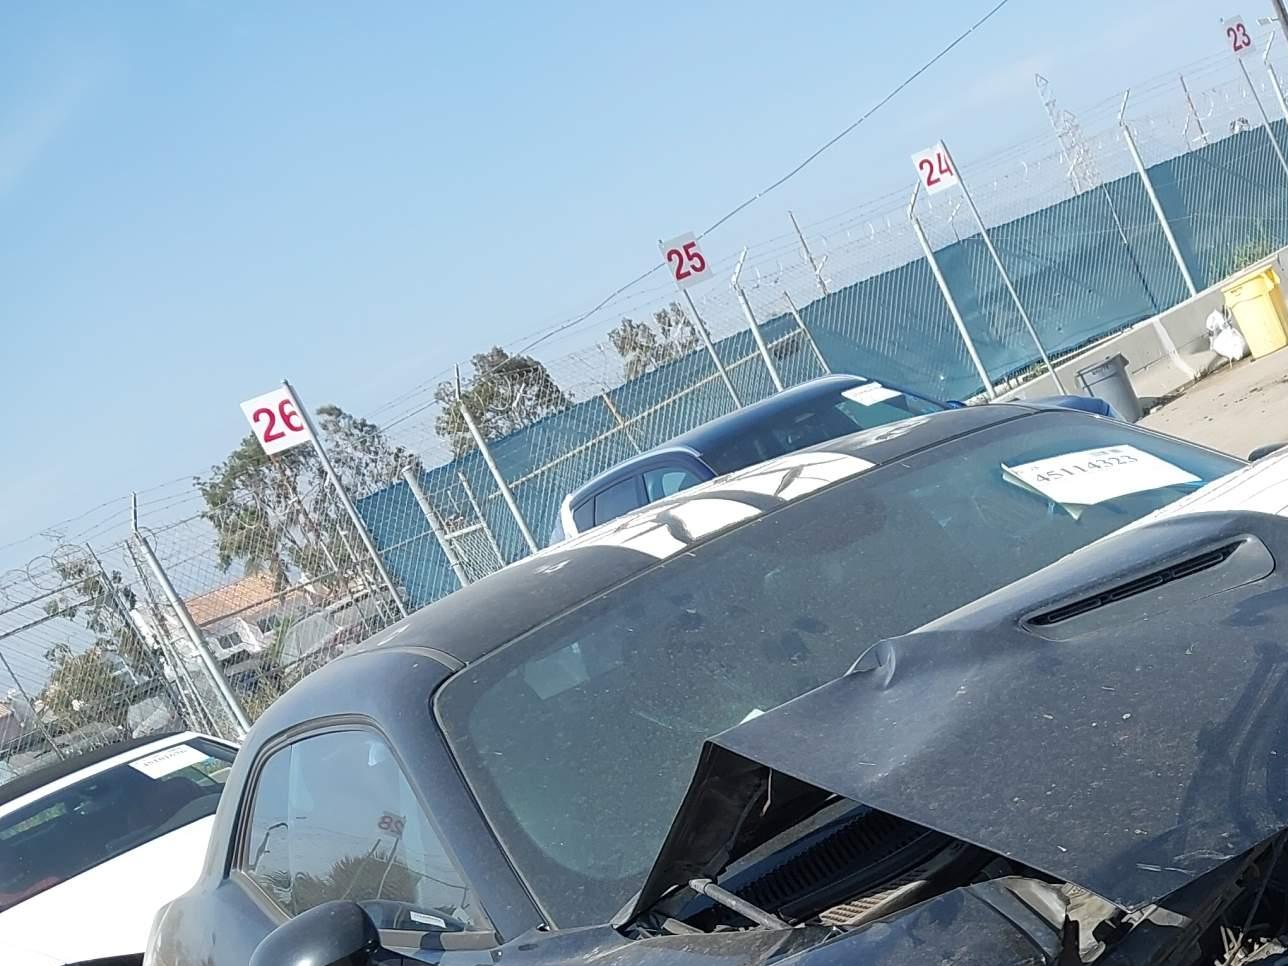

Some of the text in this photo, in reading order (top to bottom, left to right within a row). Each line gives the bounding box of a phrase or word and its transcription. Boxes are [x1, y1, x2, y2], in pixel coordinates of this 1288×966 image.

[1227, 23, 1251, 52] 23
[919, 152, 954, 187] 24
[667, 241, 706, 281] 25
[253, 398, 305, 443] 26
[1036, 455, 1139, 484] 45114323
